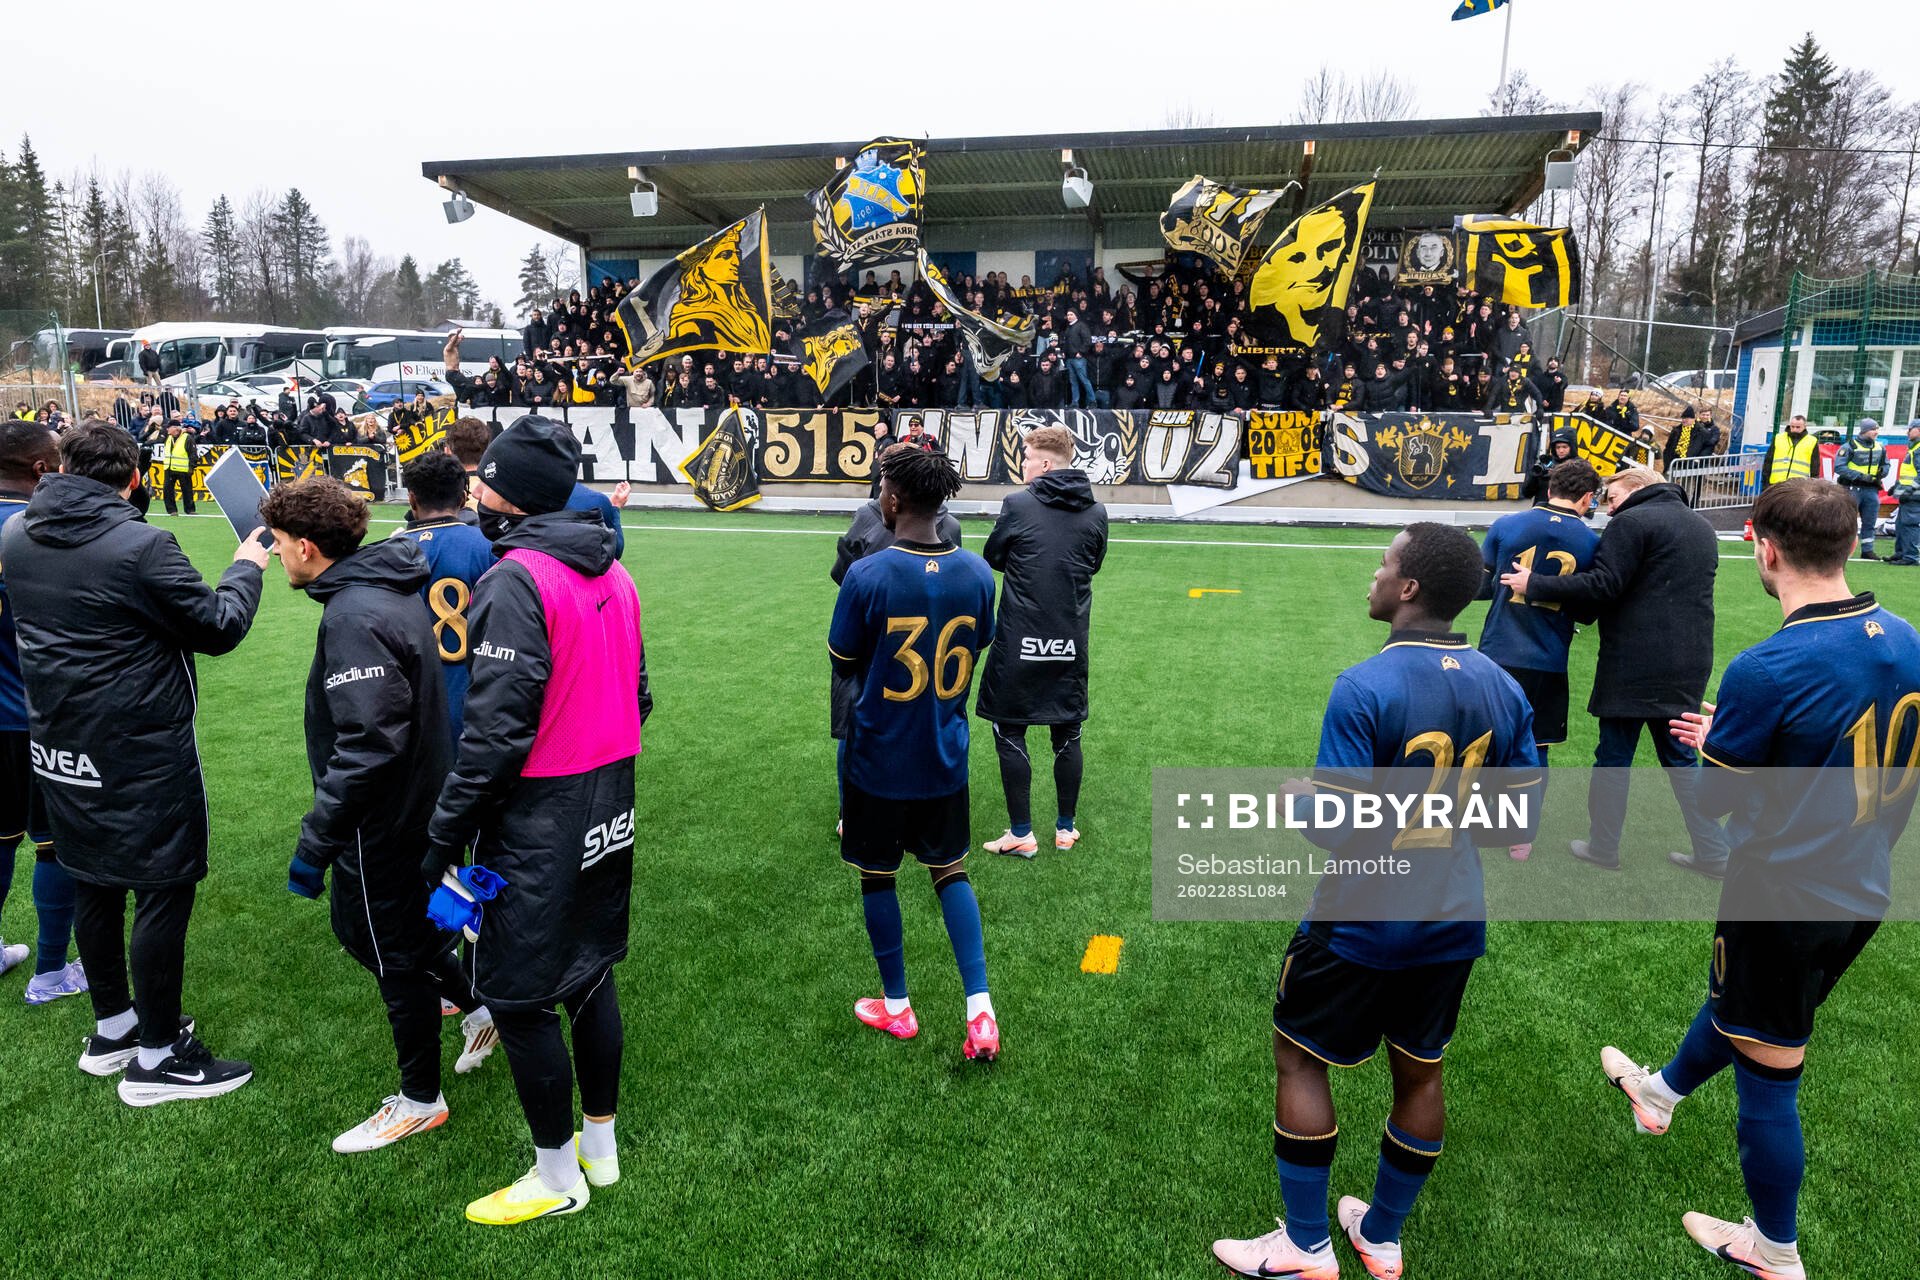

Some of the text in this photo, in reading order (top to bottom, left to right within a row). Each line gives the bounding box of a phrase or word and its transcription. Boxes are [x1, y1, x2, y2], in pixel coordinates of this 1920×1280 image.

[764, 413, 879, 477] 515
[1142, 411, 1241, 487] 02
[1251, 452, 1321, 478] TIFO
[429, 577, 470, 662] 8
[1021, 637, 1076, 655] SVEA
[326, 664, 385, 689] stadium
[473, 641, 515, 661] dium
[883, 615, 976, 702] 36
[31, 739, 101, 778] SVEA
[1843, 692, 1920, 828] 10
[1392, 729, 1493, 851] 21
[584, 807, 635, 858] SVEA
